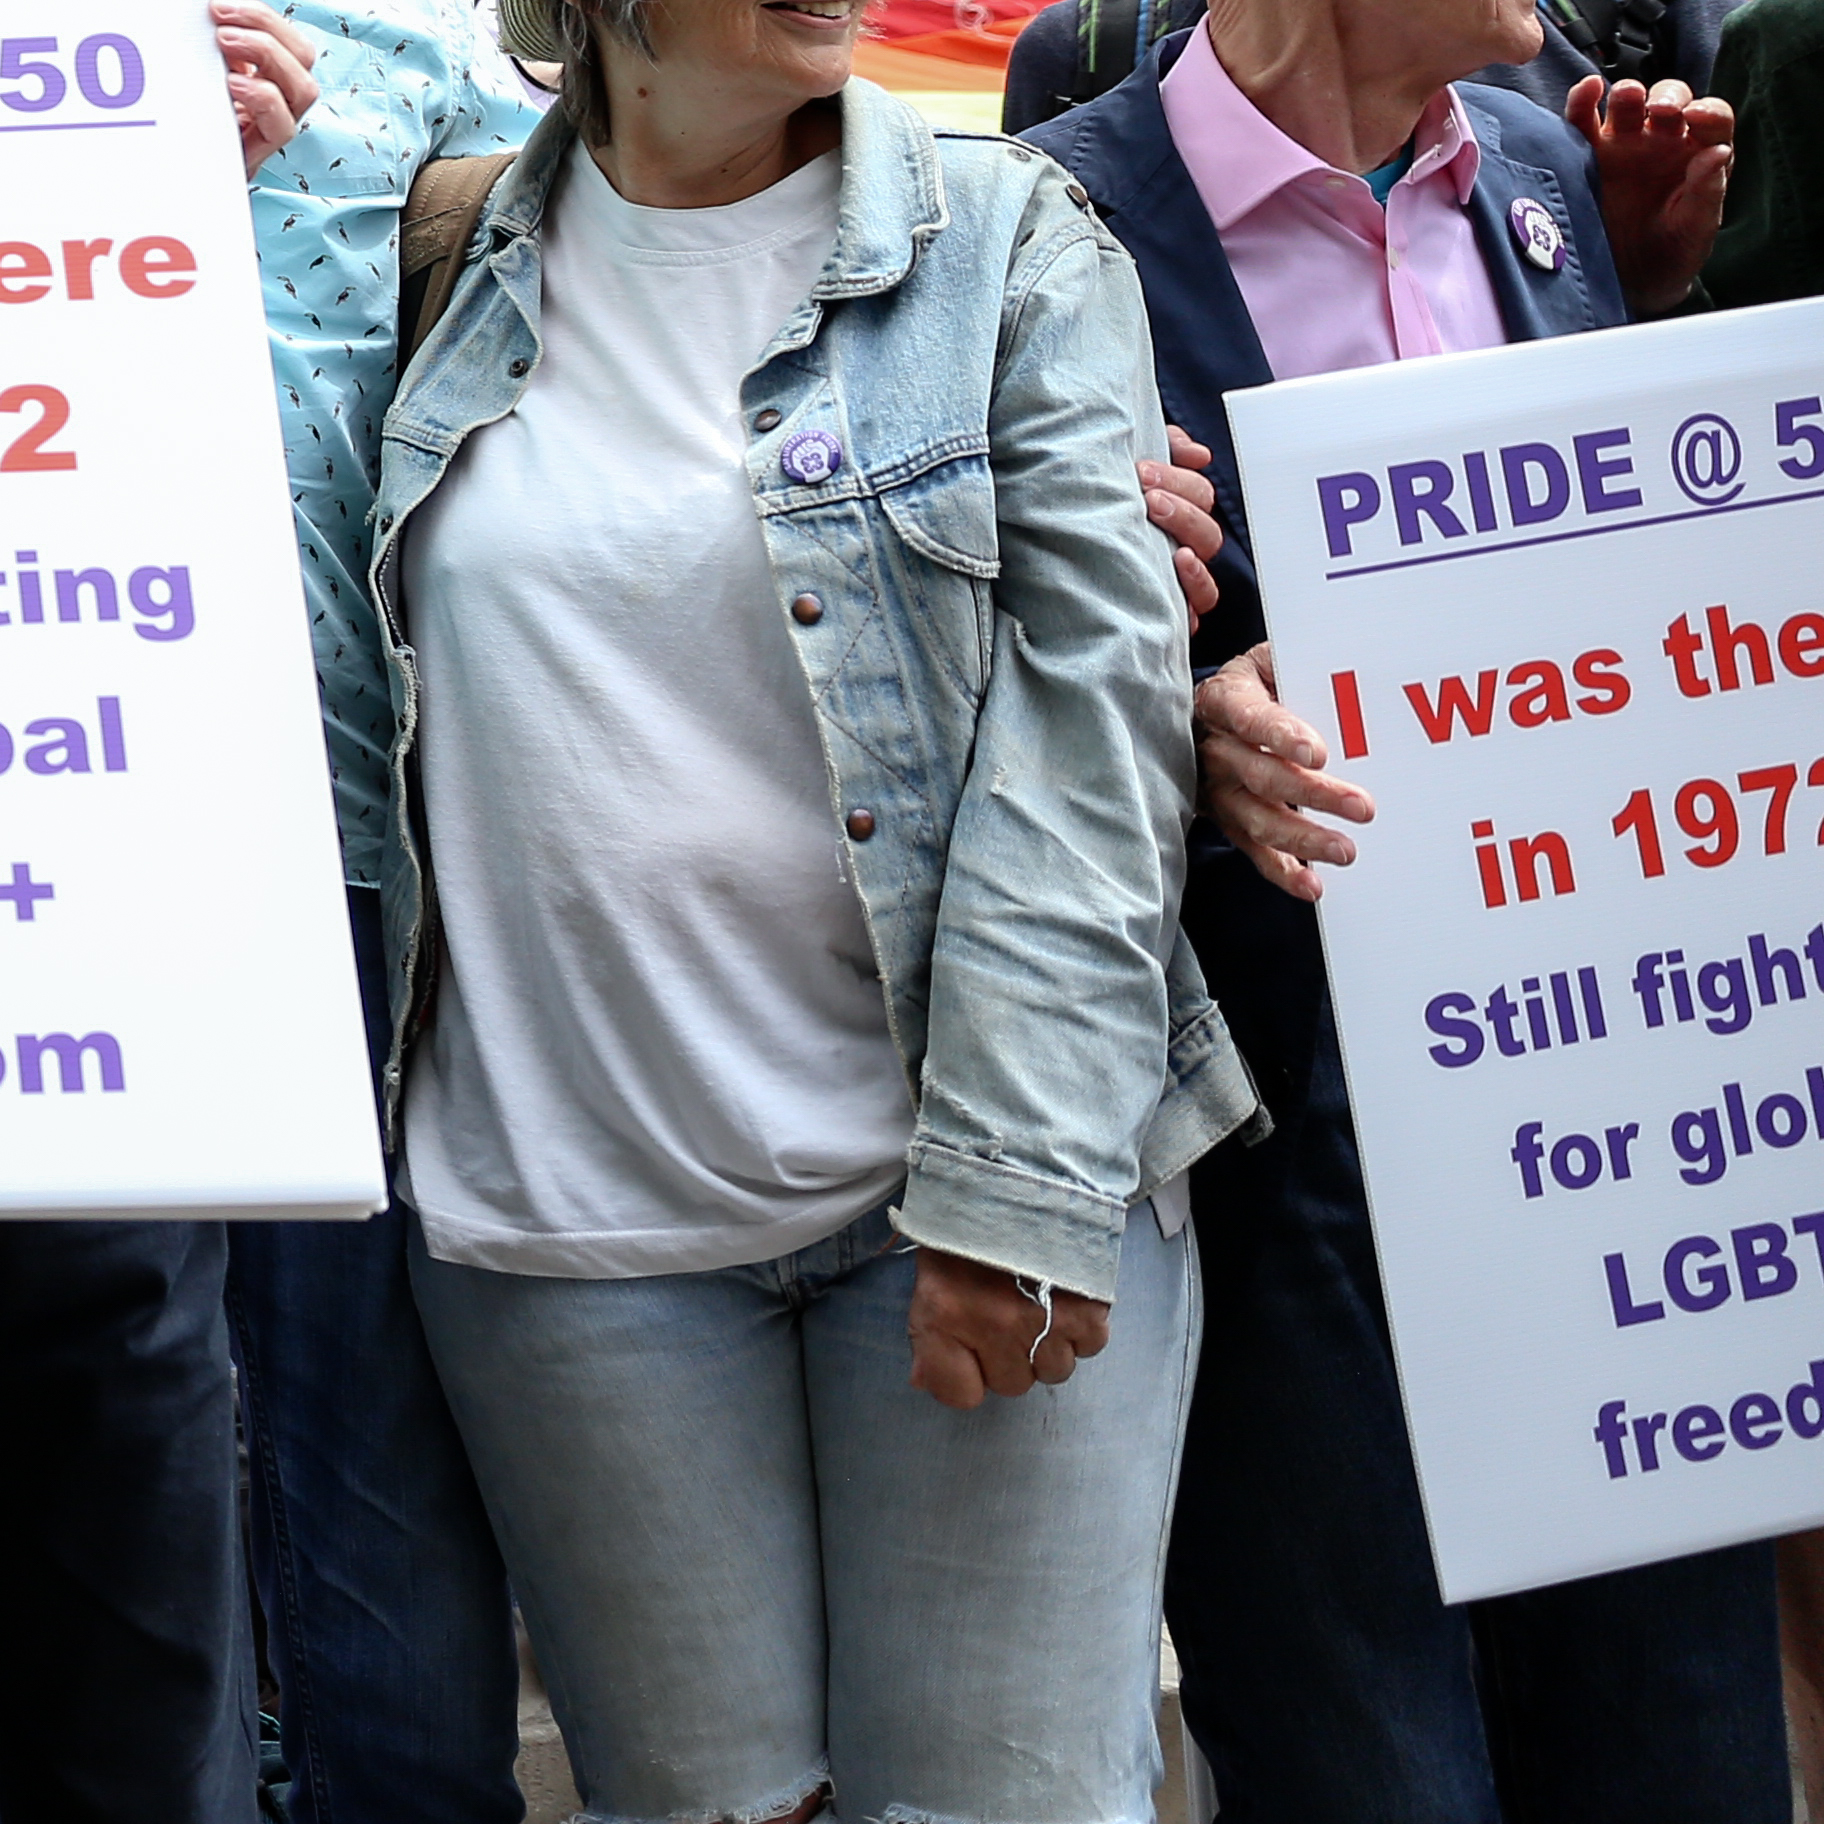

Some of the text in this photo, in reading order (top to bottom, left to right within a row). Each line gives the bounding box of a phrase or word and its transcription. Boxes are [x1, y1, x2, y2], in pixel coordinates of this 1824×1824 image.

[0, 34, 144, 112] 50
[1318, 397, 1824, 557] PRIDE @ 5
[1332, 671, 1368, 759] I
[1403, 649, 1631, 744] was
[1472, 757, 1824, 908] in 197
[1426, 967, 1607, 1068] Still
[1511, 1066, 1824, 1198] for glo
